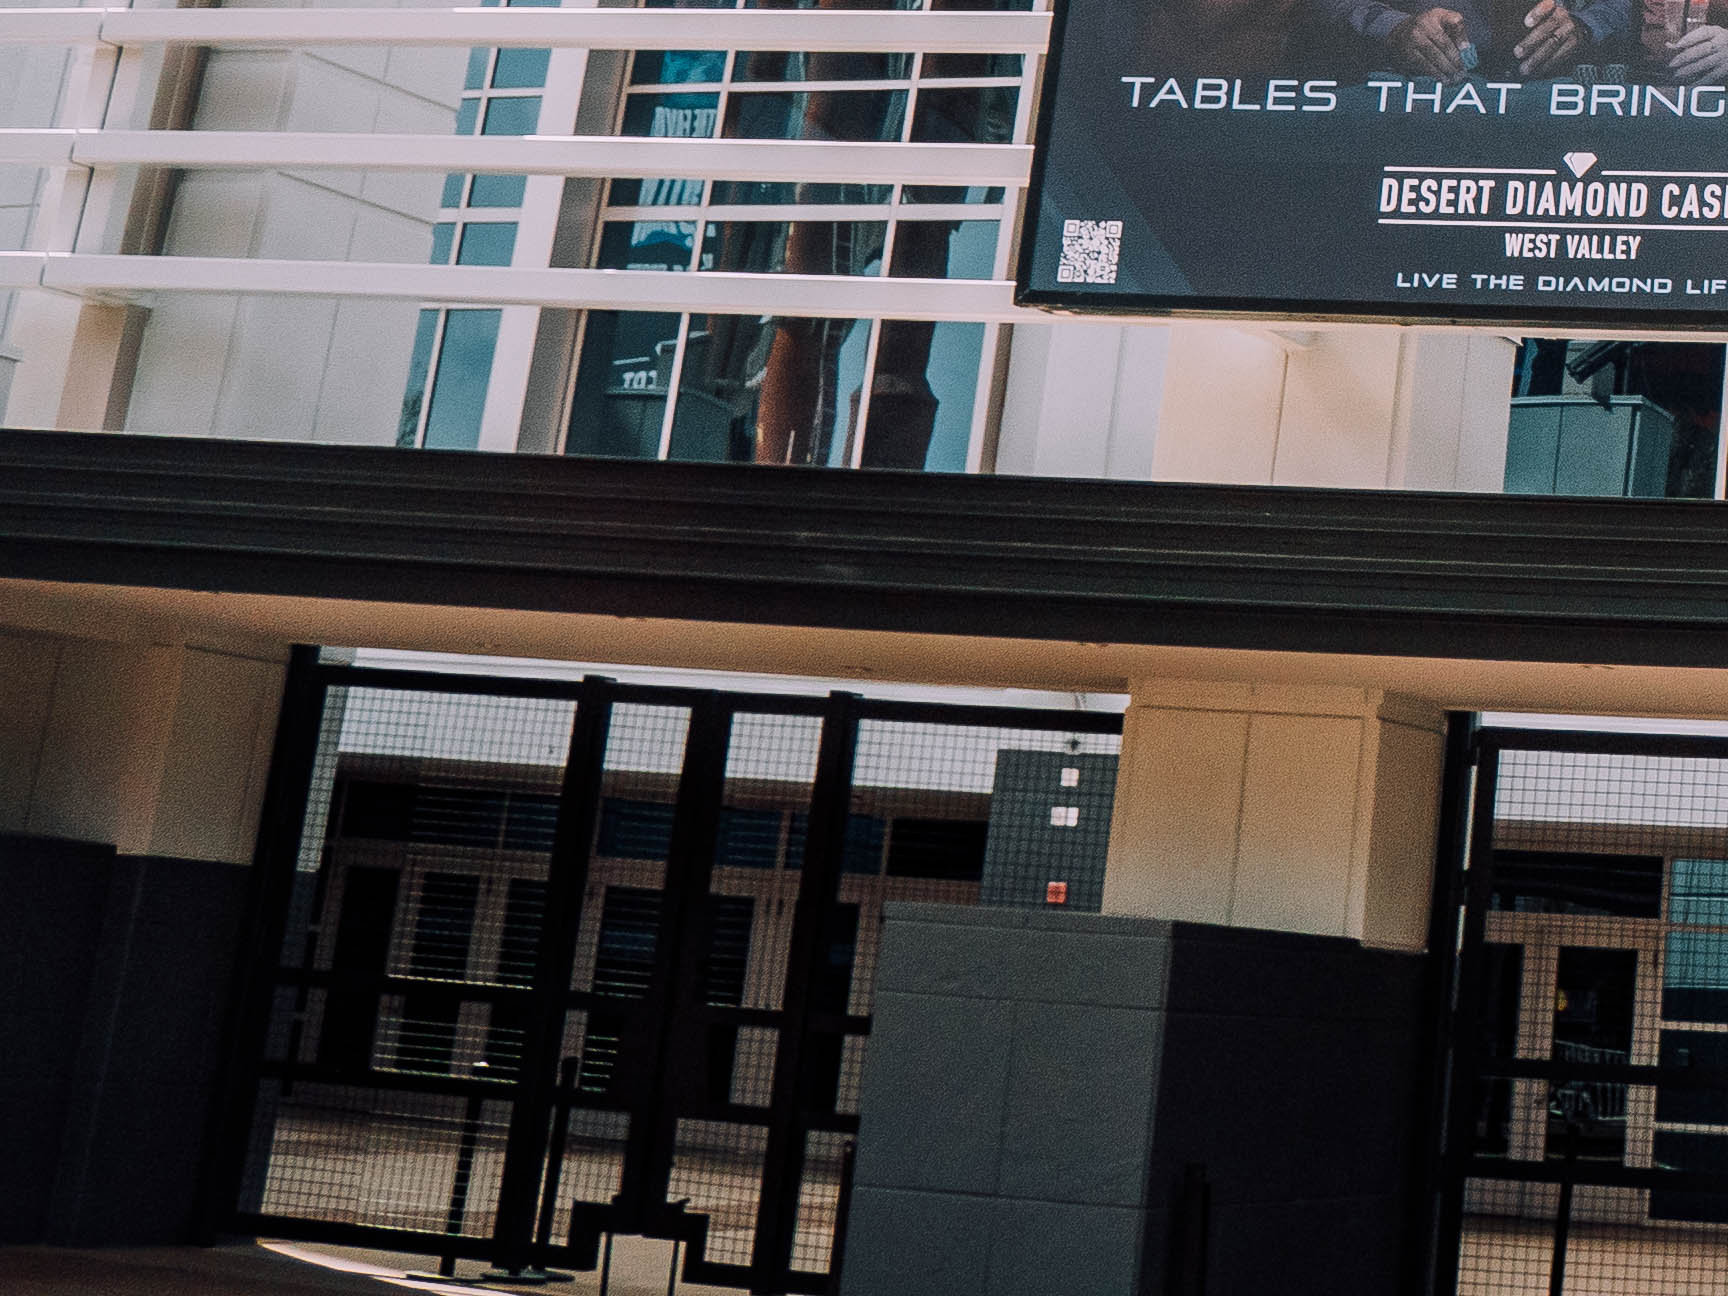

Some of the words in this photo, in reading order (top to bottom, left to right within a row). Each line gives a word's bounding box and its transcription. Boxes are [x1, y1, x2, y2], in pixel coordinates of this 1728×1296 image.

[1121, 76, 1338, 112] TABLES
[1367, 81, 1522, 114] THAT
[1549, 83, 1726, 118] BRING
[1379, 177, 1496, 215] DESERT
[1505, 180, 1648, 218] DIAMOND
[1504, 232, 1561, 259] WEST
[1566, 234, 1642, 260] VALLEY
[1396, 272, 1458, 289] LIVE
[1471, 274, 1525, 291] THE
[1537, 275, 1673, 294] DIAMOND
